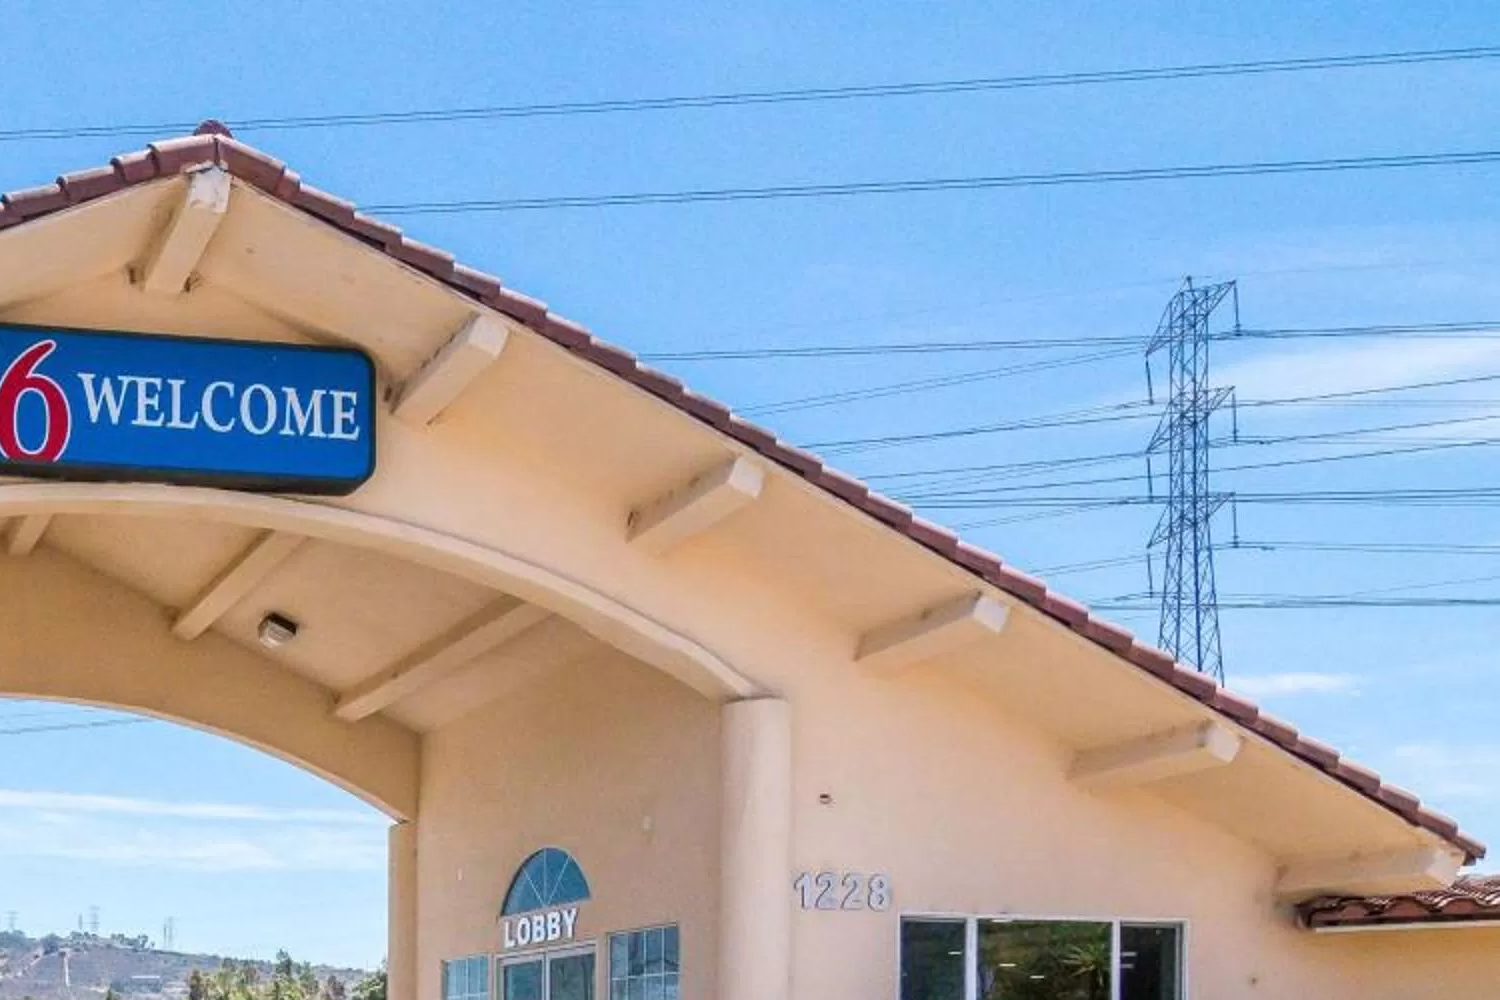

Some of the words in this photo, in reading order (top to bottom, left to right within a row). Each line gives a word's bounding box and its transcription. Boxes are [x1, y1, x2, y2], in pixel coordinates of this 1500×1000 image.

[76, 371, 360, 442] WELCOME
[793, 871, 892, 912] 1228
[503, 907, 578, 949] LOBBY
